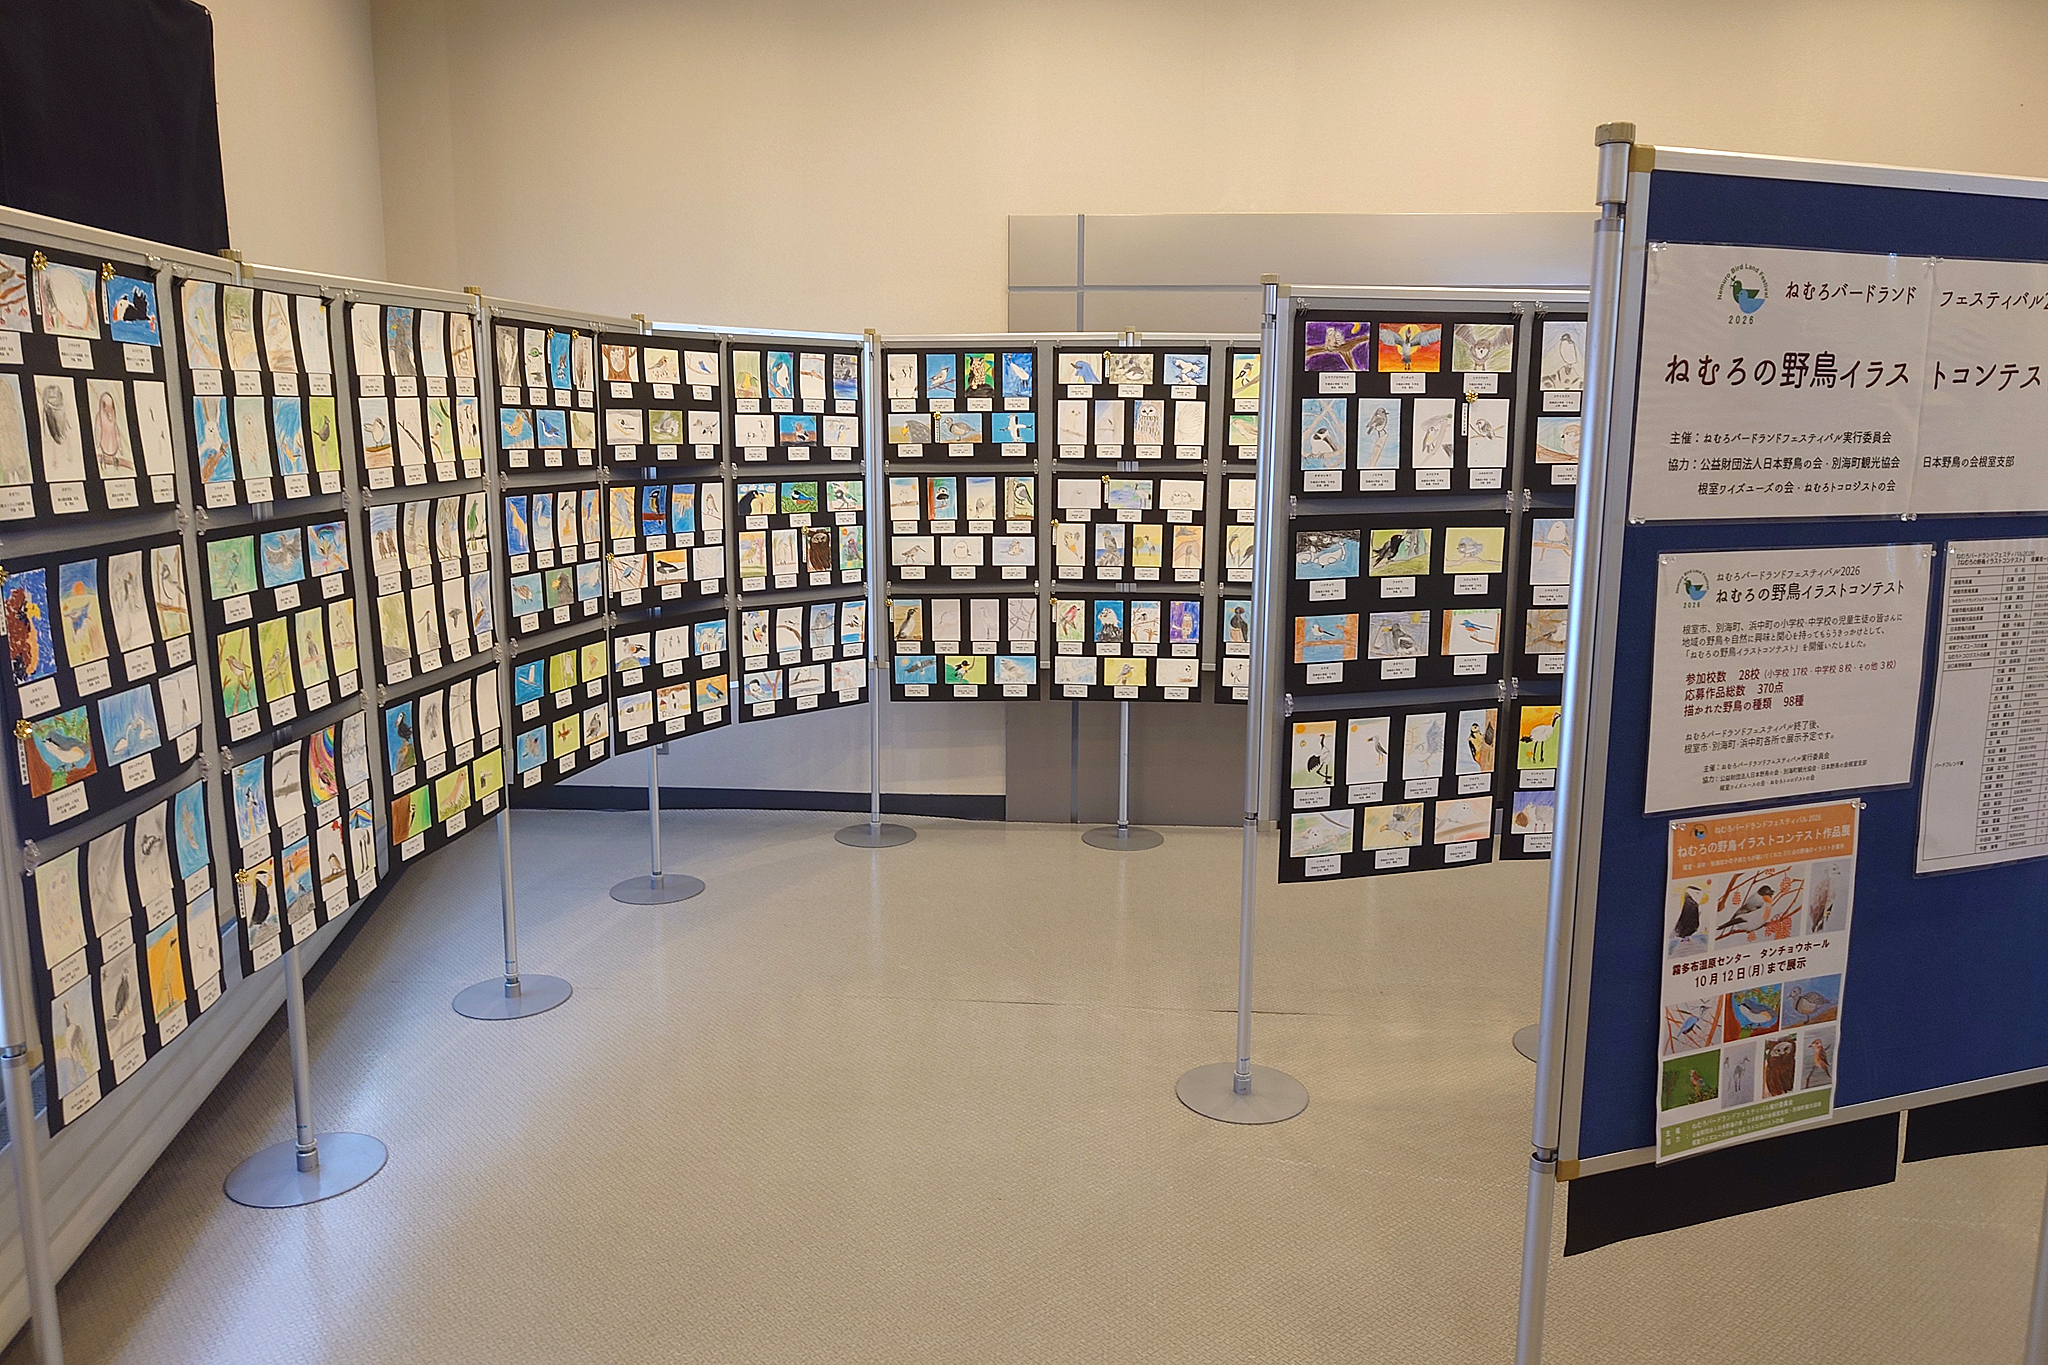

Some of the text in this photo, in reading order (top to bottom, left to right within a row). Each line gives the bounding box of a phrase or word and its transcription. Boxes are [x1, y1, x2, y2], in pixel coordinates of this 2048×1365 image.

[1717, 263, 1769, 300] Nemuro Bird Land Festival
[1785, 281, 1917, 305] ねむろバードランド
[1728, 315, 1754, 325] 2026
[1664, 350, 2041, 391] ねむろの野鳥イラス トコンテス
[1923, 455, 2015, 468] 日本野鳥の会根室支部
[1715, 580, 1905, 604] ねむろの野鳥イラストコンテスト
[1685, 670, 1727, 685] 参加校数
[1738, 668, 1760, 681] 28校
[1685, 681, 1784, 701] 応募作品総数 370点
[1684, 694, 1804, 717] 描かれた野鳥の種類 98種
[1677, 824, 1851, 858] ねむろの野鳥イラストコンテスト作品展
[1760, 939, 1830, 959] タンチョウホール
